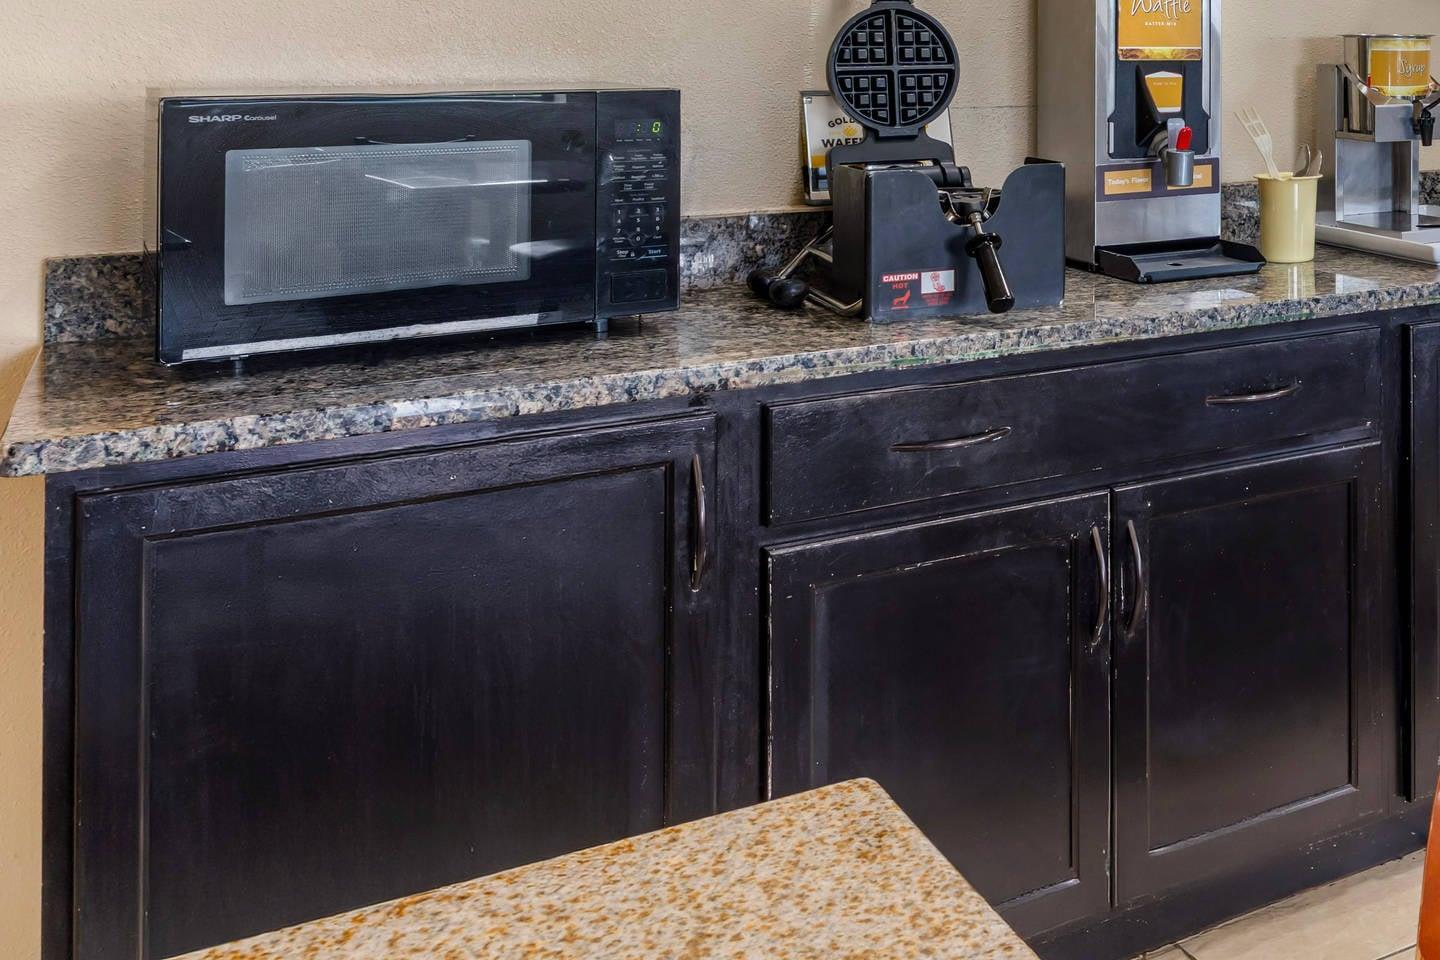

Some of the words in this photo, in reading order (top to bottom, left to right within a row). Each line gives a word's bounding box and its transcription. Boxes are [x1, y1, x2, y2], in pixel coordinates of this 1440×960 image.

[1400, 54, 1425, 77] Syrup
[188, 115, 242, 123] SHARP
[882, 272, 919, 282] CAUTION
